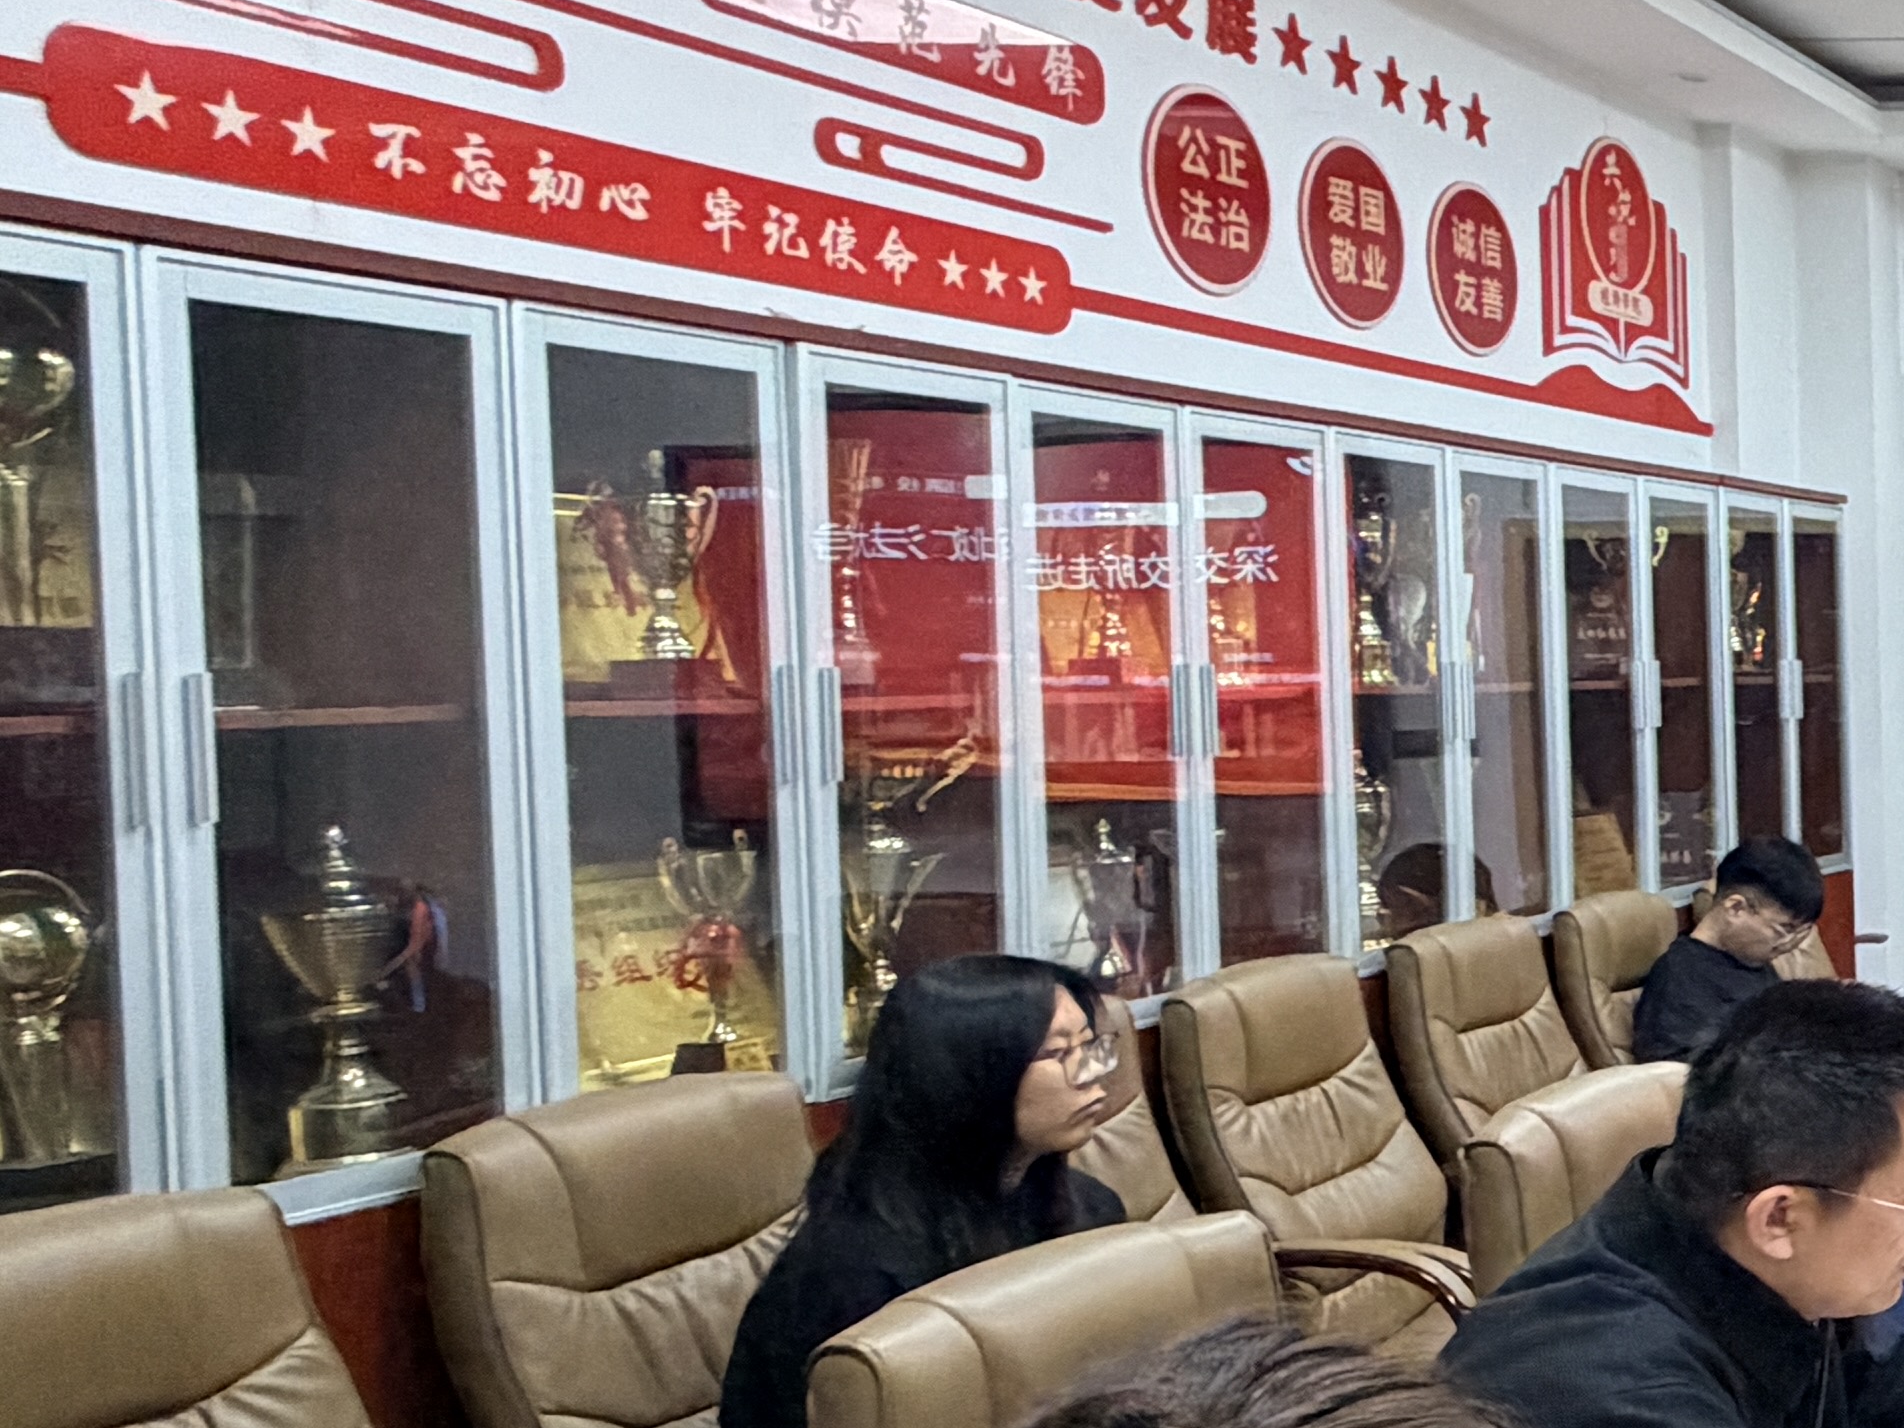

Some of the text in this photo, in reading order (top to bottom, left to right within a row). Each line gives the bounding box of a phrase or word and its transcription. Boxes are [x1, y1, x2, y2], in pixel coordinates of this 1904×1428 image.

[1177, 124, 1249, 189] 公正
[368, 121, 919, 286] 不忘初心 牢记使命
[1180, 188, 1251, 253] 法治
[1327, 176, 1386, 235] 爱国
[1329, 235, 1389, 292] 敬业
[1451, 214, 1503, 269] 诚信
[1453, 269, 1504, 322] 友善
